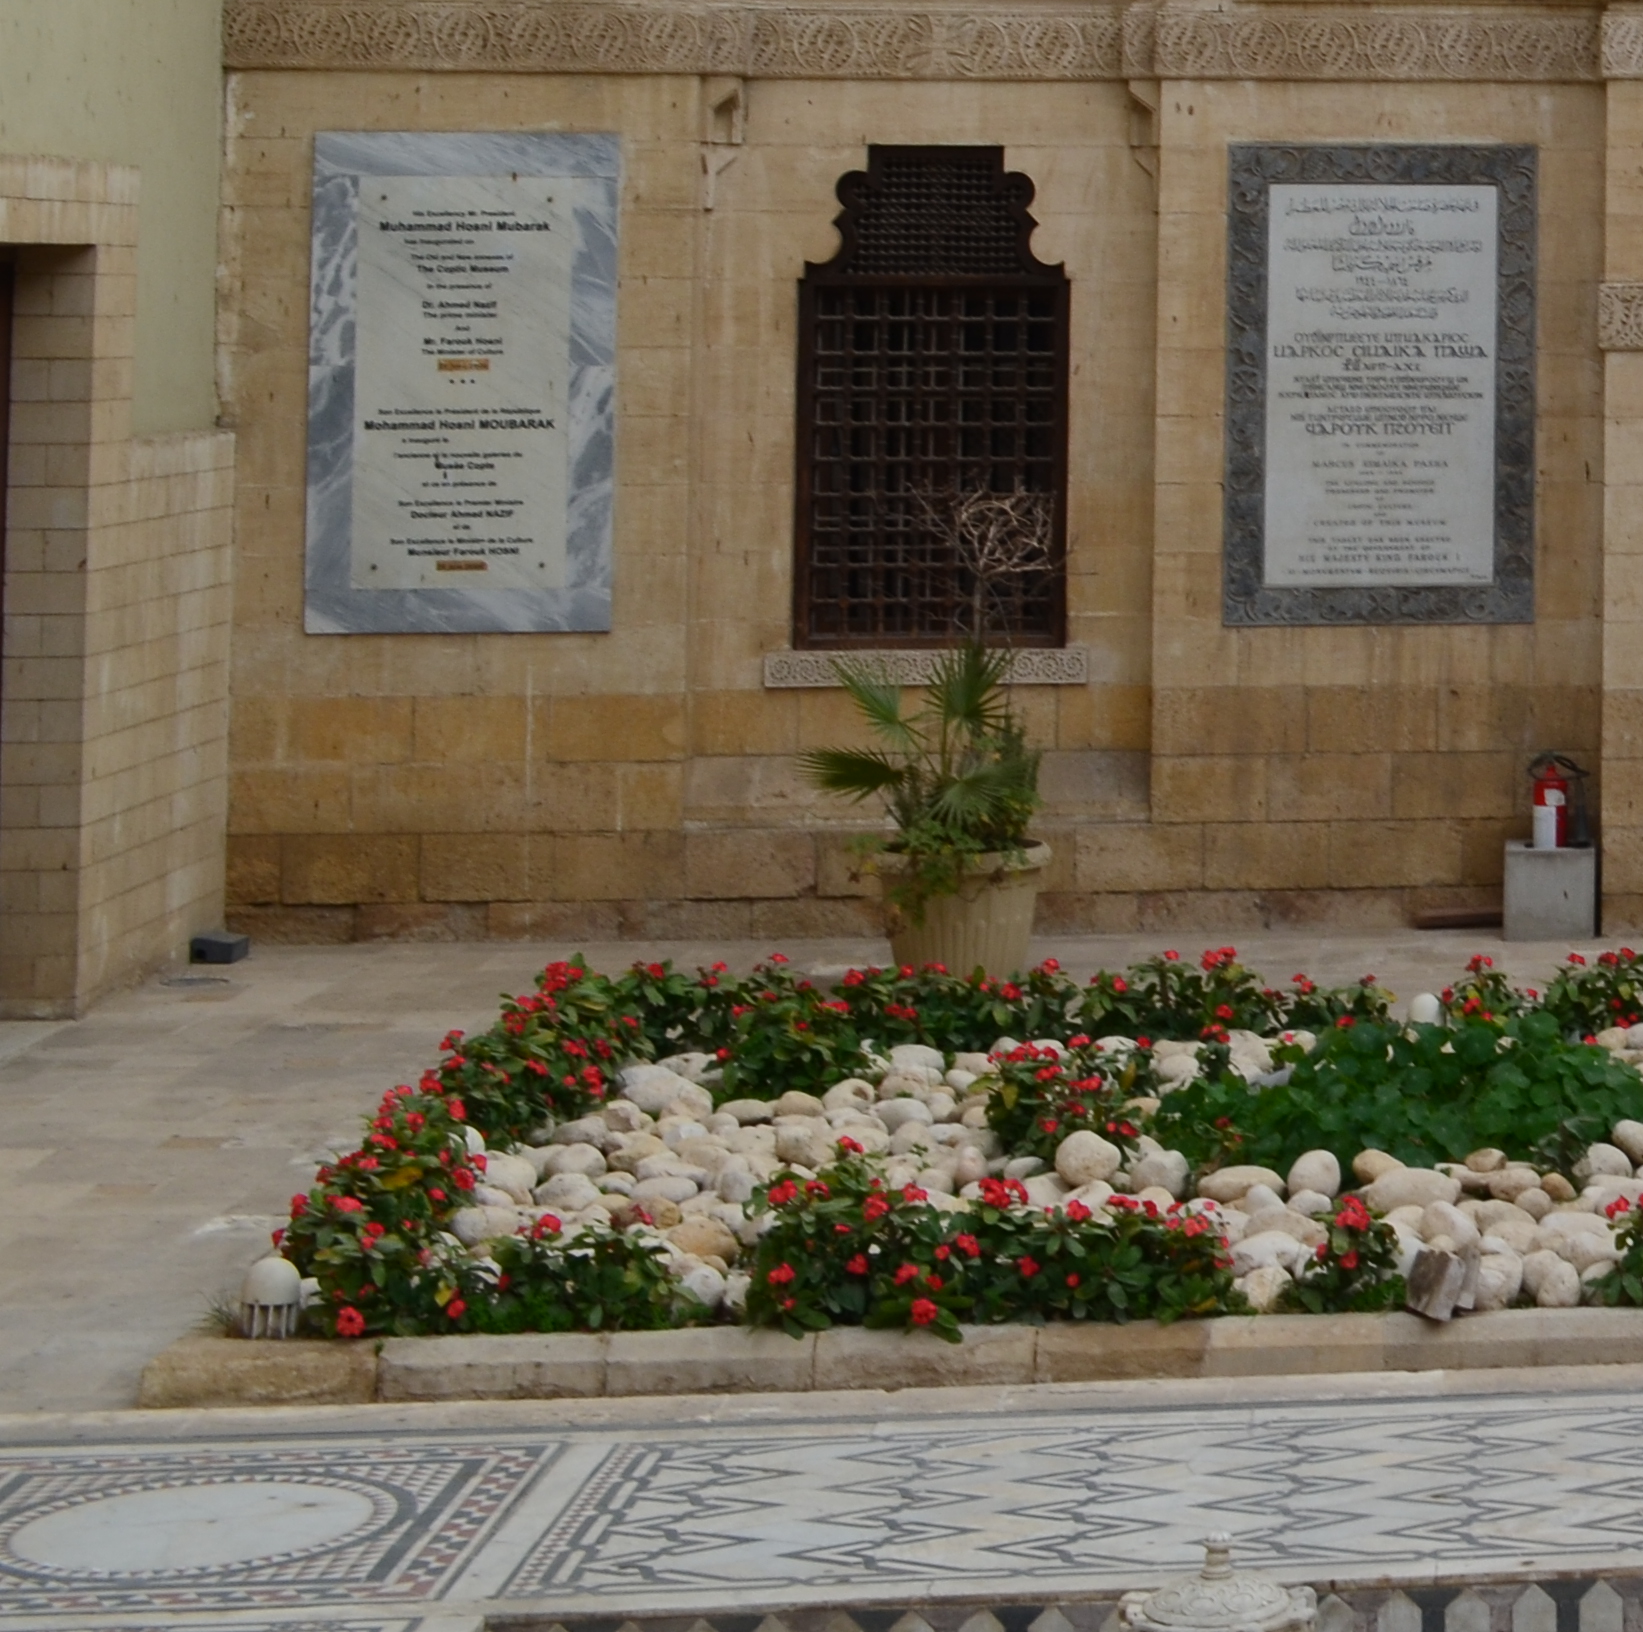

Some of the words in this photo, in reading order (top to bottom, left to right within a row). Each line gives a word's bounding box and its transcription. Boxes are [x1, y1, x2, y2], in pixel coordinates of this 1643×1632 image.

[379, 221, 452, 231] Muhammad
[456, 221, 492, 231] Hosni
[496, 221, 551, 231] Mubarak
[364, 419, 436, 430] Mohammad
[439, 419, 475, 430] Hosni
[478, 419, 555, 430] MOUBARAK
